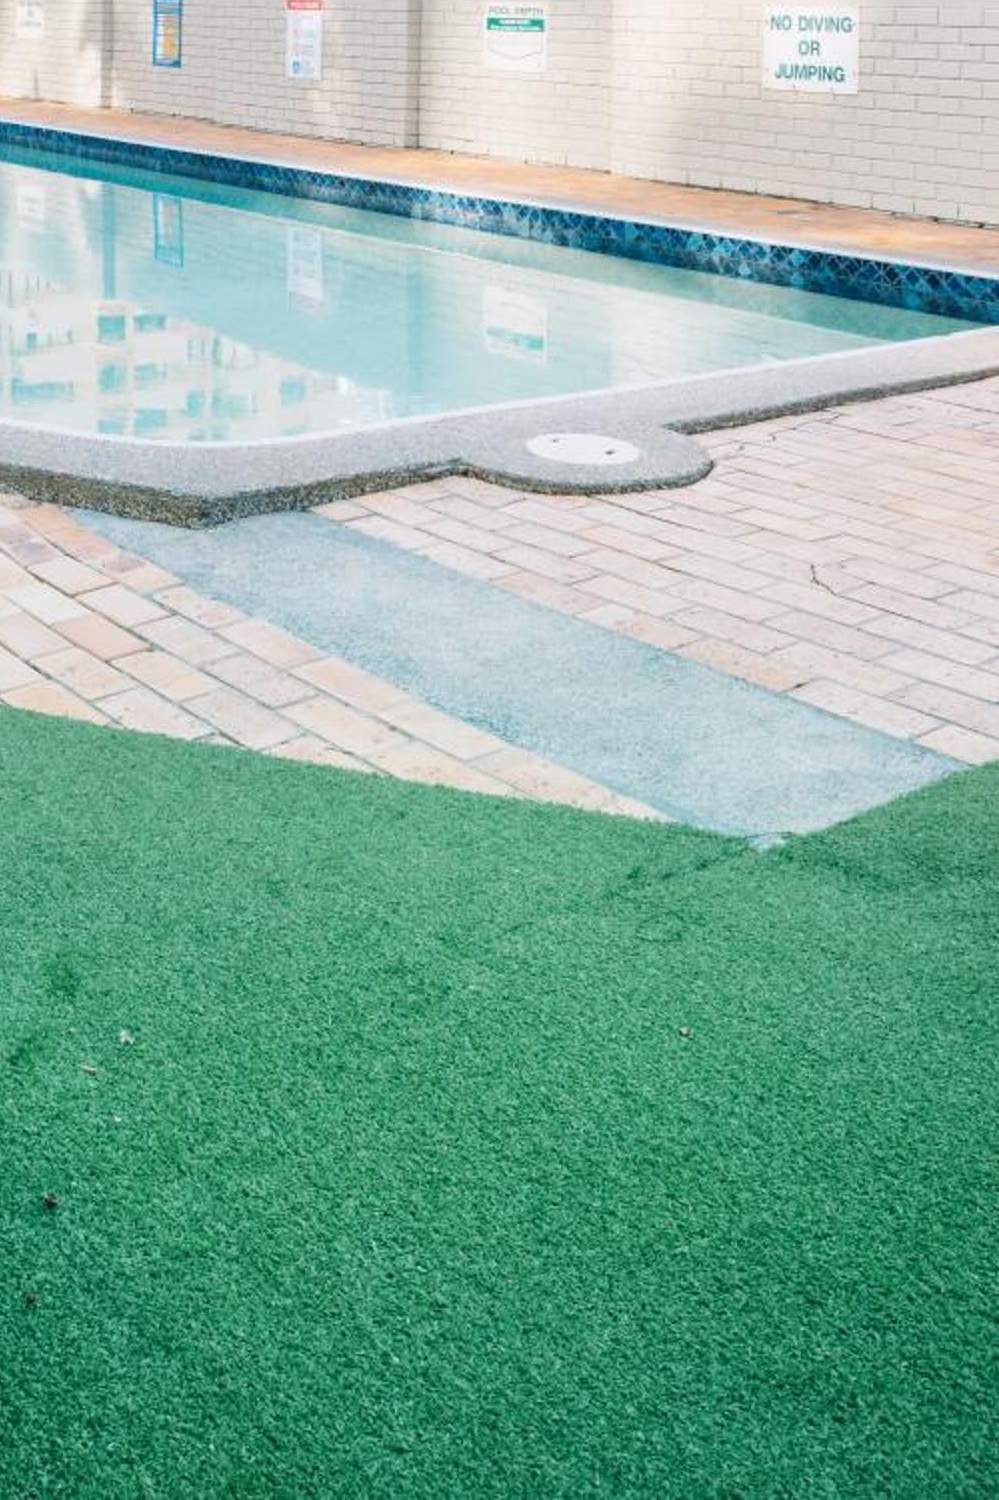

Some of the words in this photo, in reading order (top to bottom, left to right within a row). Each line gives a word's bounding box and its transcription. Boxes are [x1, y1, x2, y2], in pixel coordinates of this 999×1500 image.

[770, 14, 792, 31] NO
[798, 15, 853, 33] DIVING
[798, 39, 821, 56] OR
[774, 63, 846, 83] JUMPING
